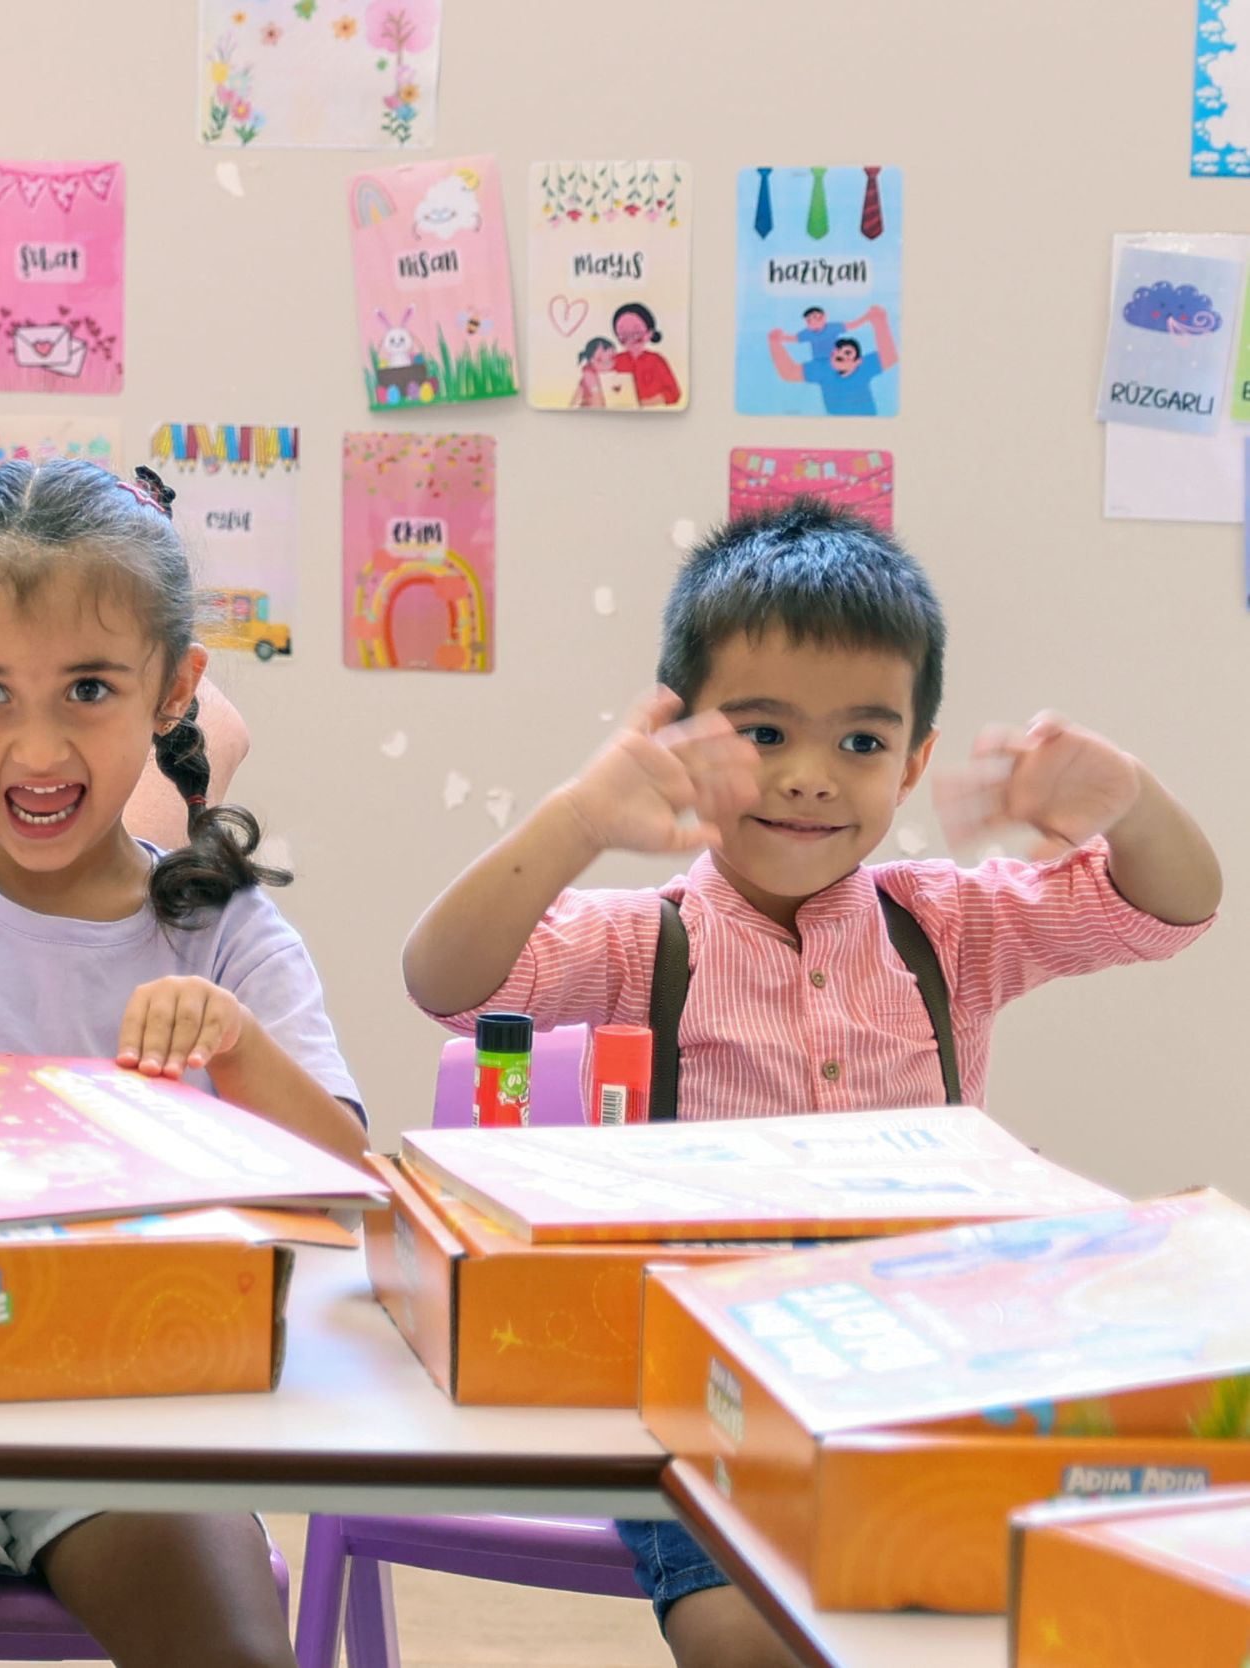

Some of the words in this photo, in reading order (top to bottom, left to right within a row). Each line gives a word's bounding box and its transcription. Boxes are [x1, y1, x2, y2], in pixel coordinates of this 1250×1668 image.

[768, 258, 868, 286] haziran
[1110, 380, 1215, 415] RÜZGARLI
[1066, 1465, 1132, 1493] ADIM
